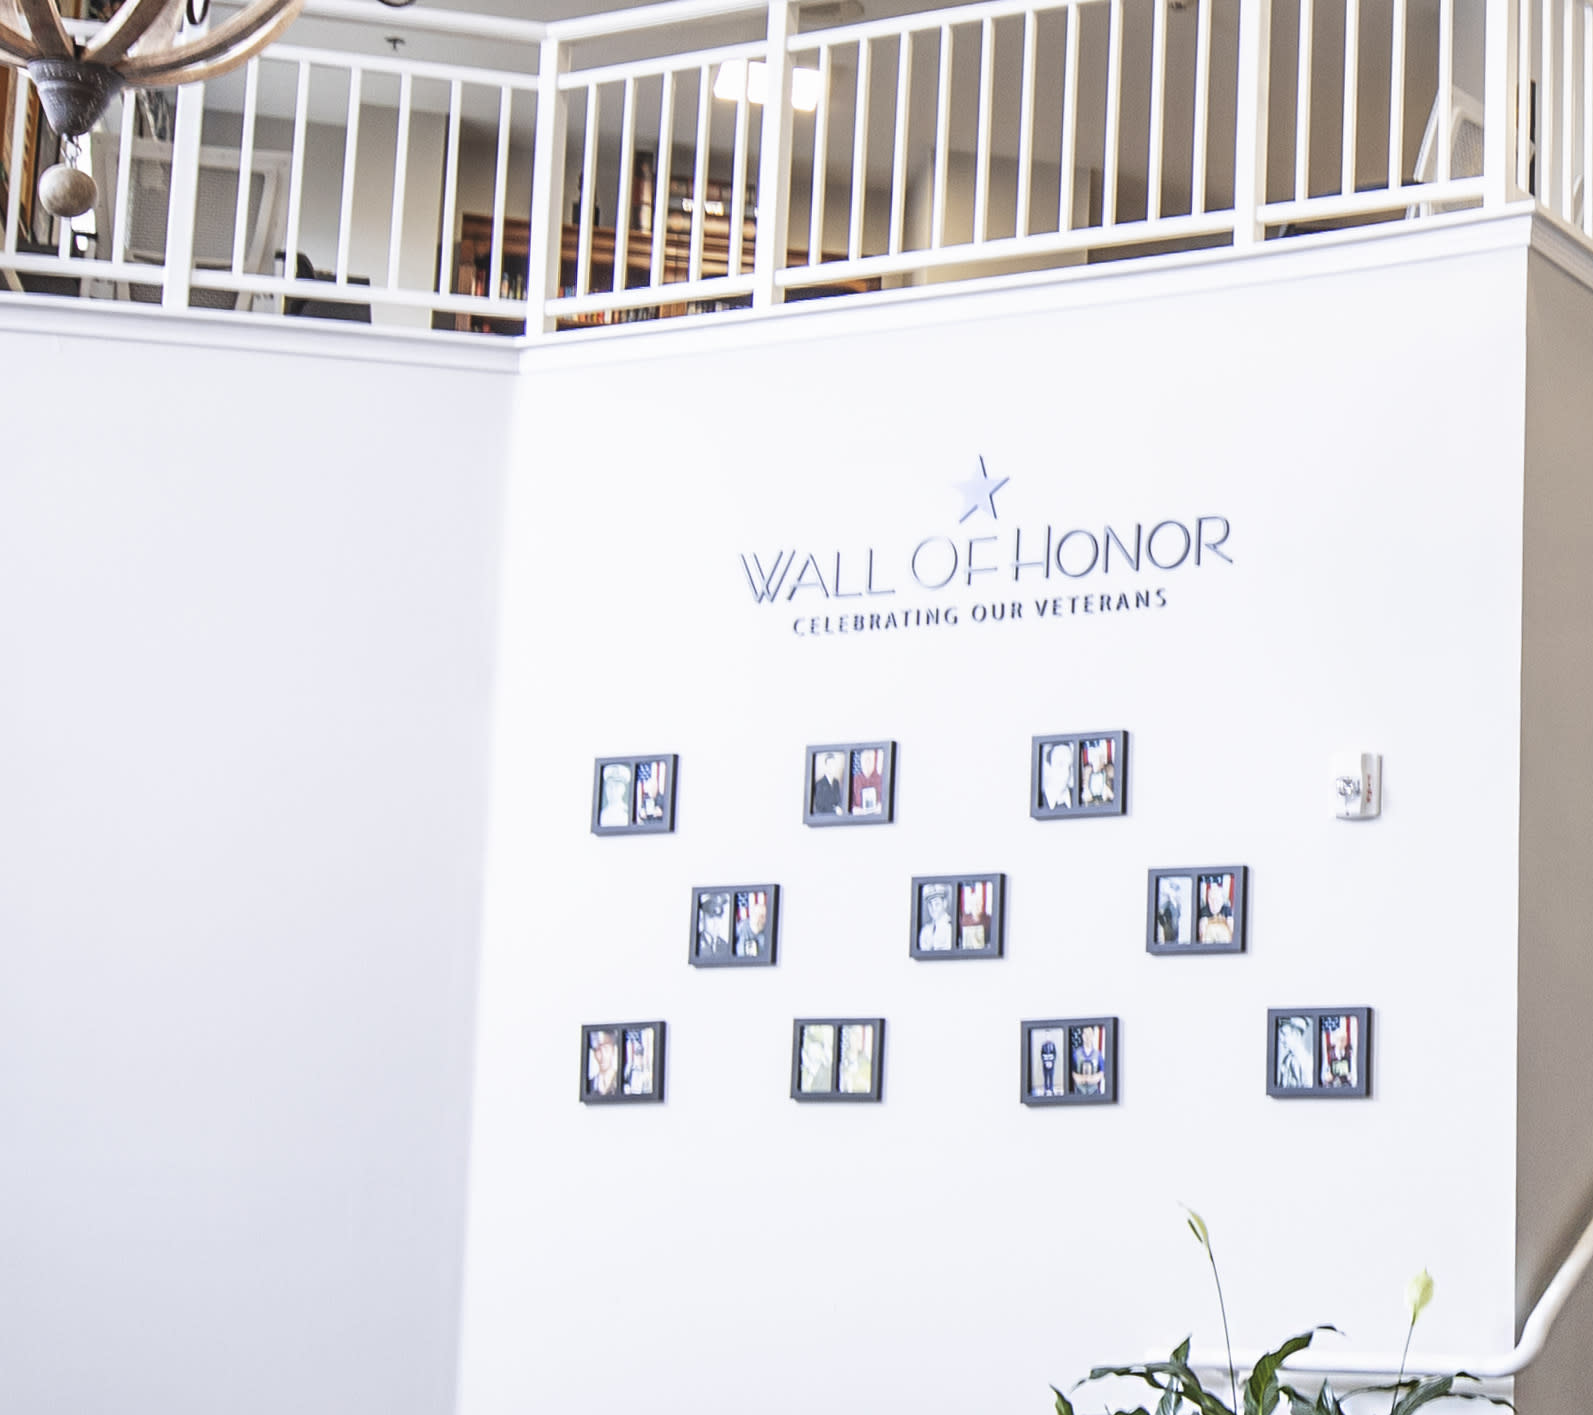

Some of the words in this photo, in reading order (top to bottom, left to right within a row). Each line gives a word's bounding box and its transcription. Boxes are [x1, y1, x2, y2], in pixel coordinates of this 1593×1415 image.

[739, 547, 897, 605] WALL
[911, 535, 999, 591] OF
[1011, 515, 1234, 583] HONOR
[792, 606, 959, 637] CELEBRATING
[970, 600, 1023, 624] OUR
[1034, 587, 1168, 619] VETERANS
